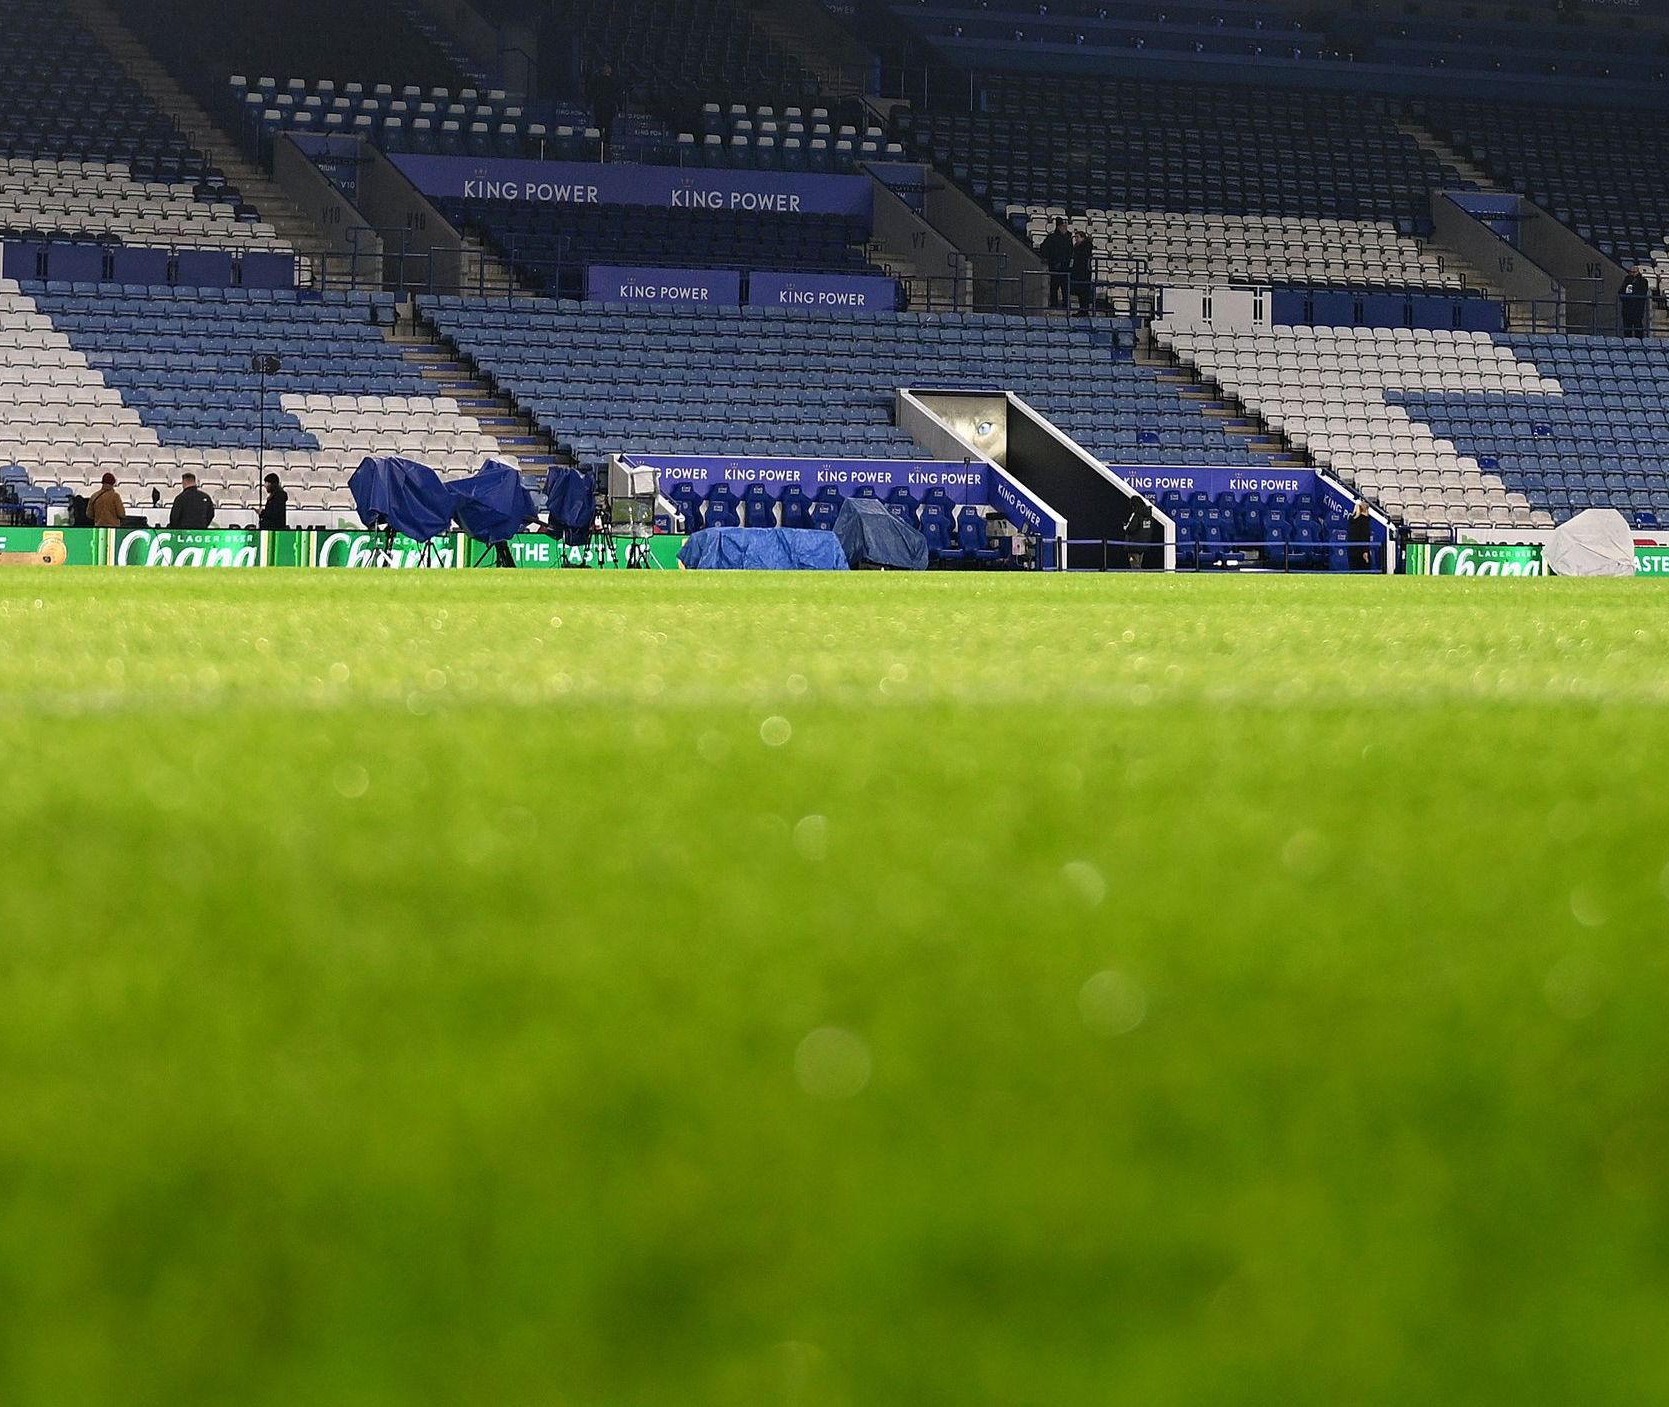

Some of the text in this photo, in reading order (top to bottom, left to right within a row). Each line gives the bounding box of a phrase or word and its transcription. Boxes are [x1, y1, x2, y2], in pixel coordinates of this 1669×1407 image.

[340, 181, 356, 189] V10
[463, 180, 599, 204] KING POWER
[671, 189, 801, 212] KING POWER
[620, 284, 709, 300] KING POWER
[779, 290, 865, 306] KING POWER
[665, 468, 708, 480] POWER
[724, 469, 801, 482] KING POWER
[817, 471, 892, 483] KING POWER
[908, 472, 982, 485] KING POWER
[1123, 477, 1194, 489] KING POWER
[1230, 478, 1298, 491] KING POWER
[997, 483, 1042, 528] KING POWER
[1323, 494, 1343, 513] KING
[177, 535, 220, 544] LAGER
[511, 543, 550, 562] THE
[1477, 550, 1512, 558] LAGER
